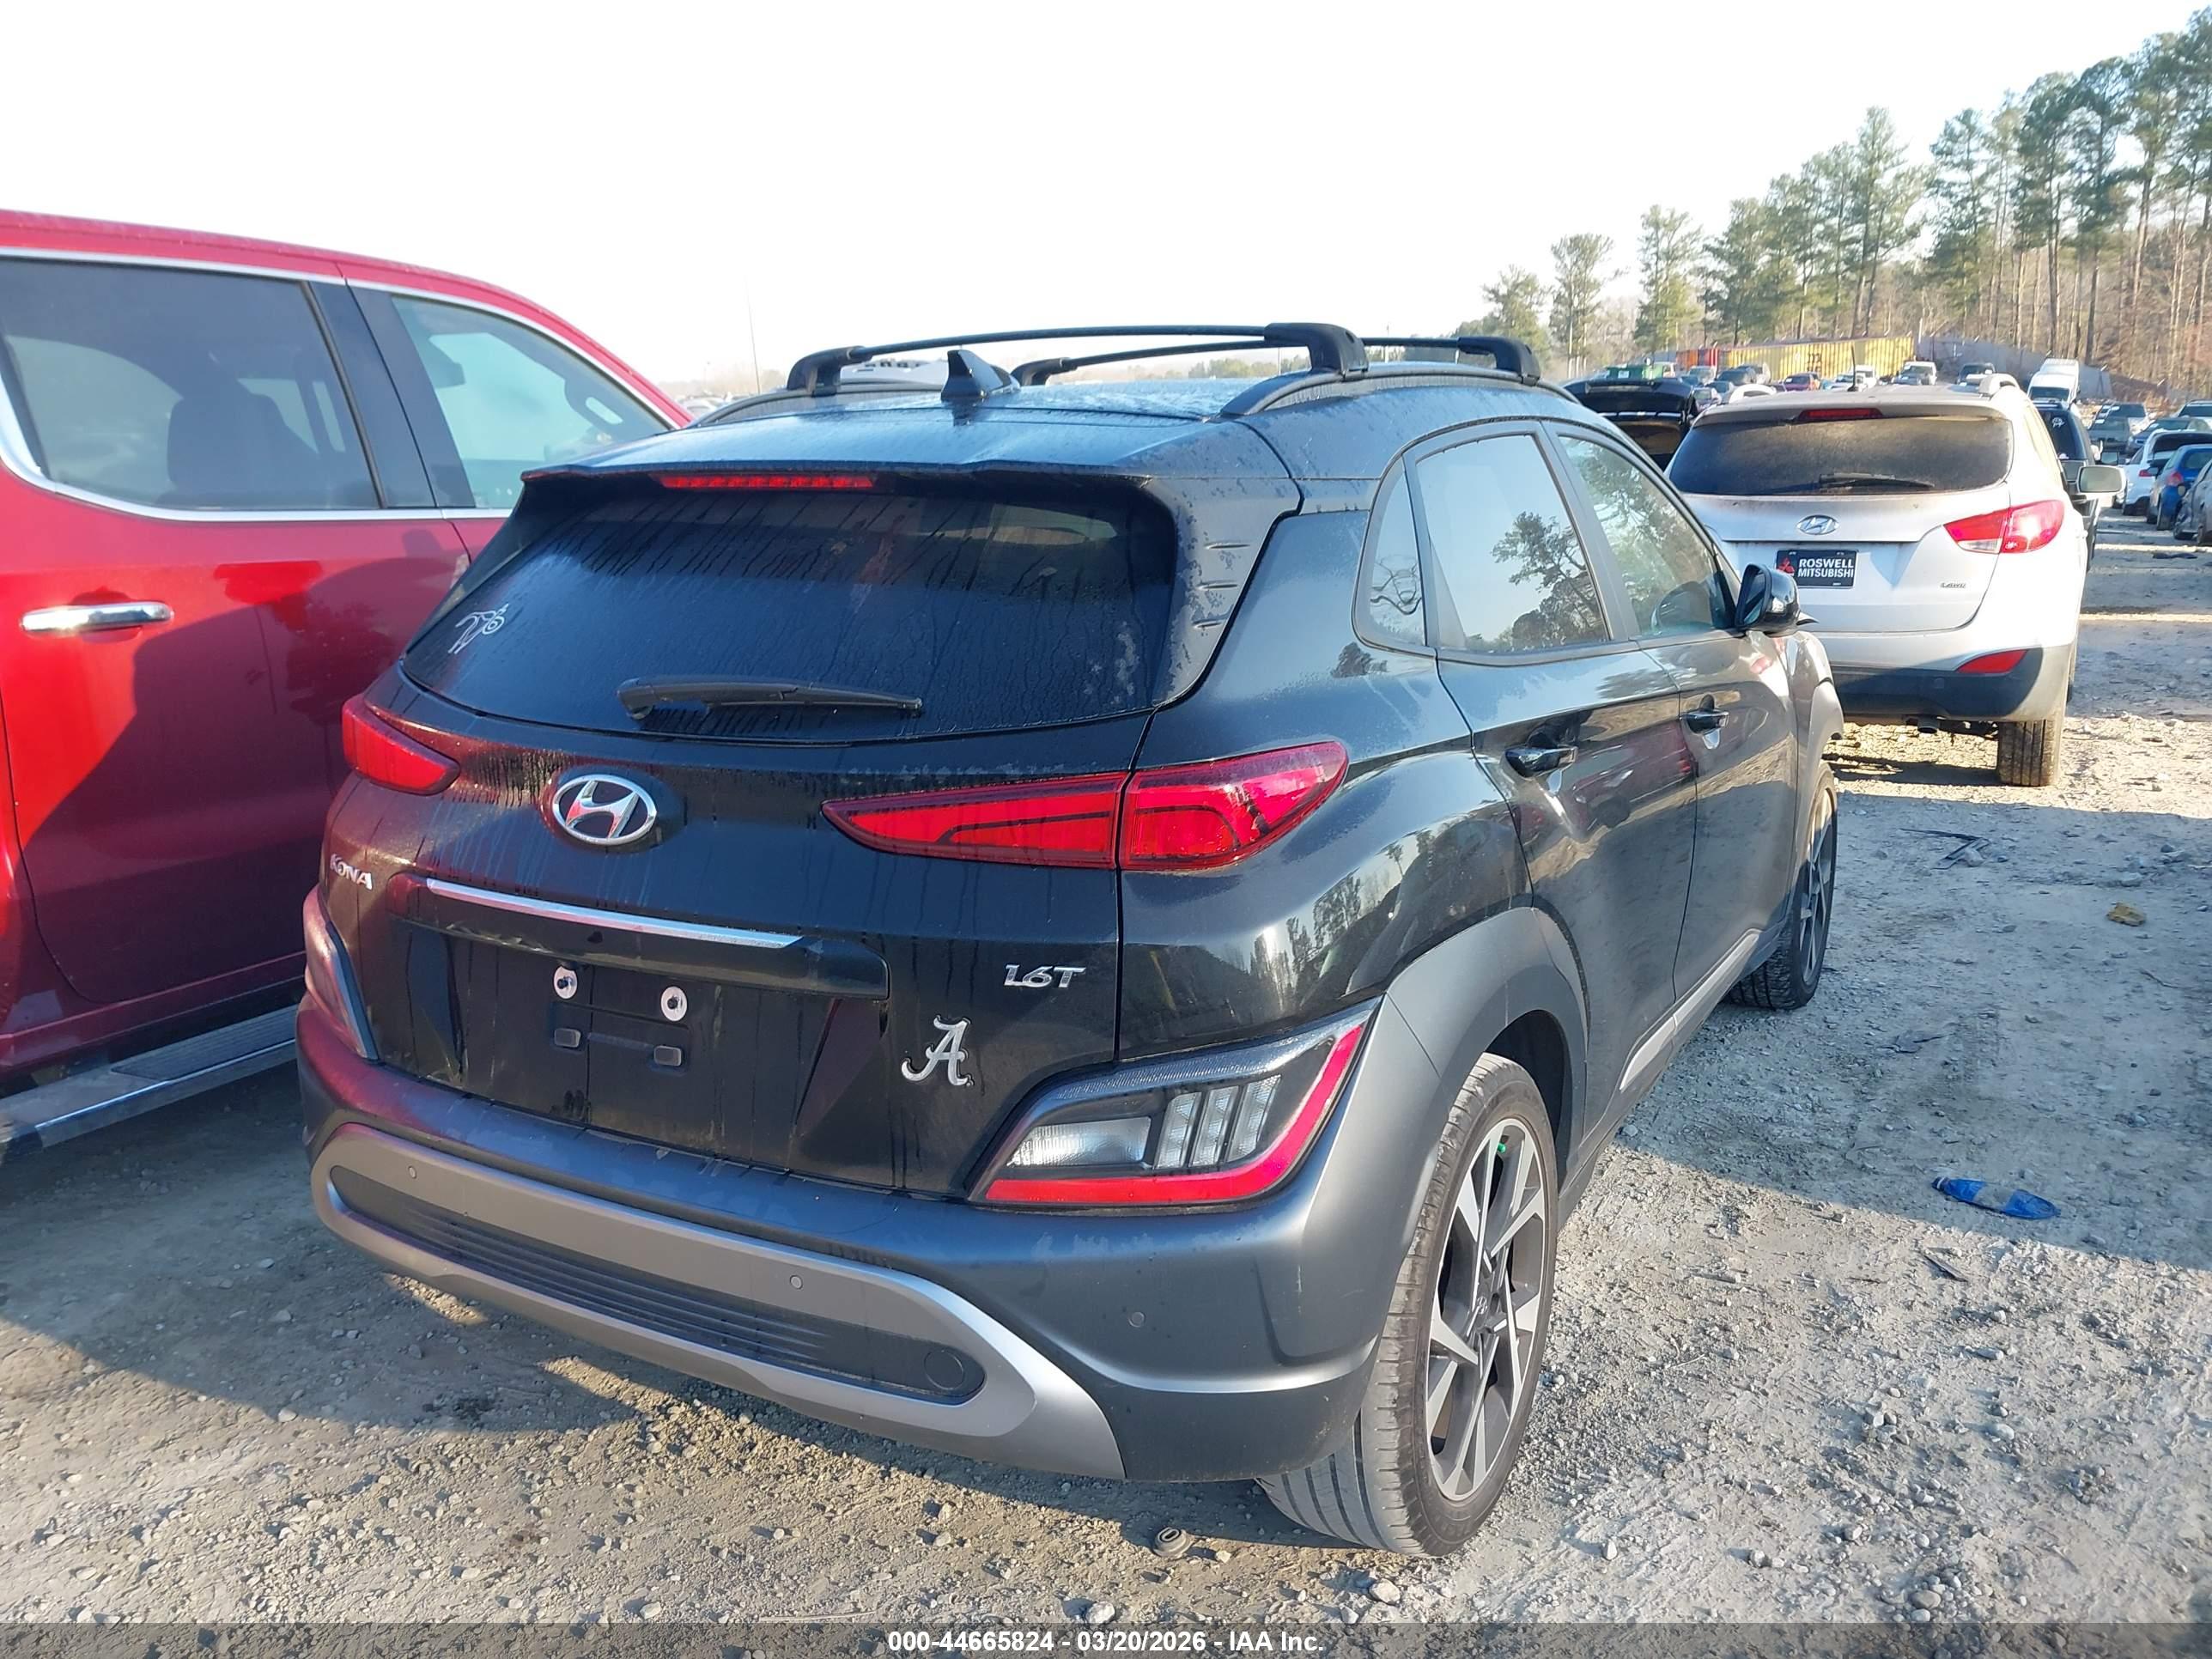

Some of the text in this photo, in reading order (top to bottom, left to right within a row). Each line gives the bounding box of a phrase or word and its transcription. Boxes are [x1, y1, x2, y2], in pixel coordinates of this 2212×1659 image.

[1799, 558, 1855, 568] ROSWELL
[1797, 568, 1855, 578] MITSUBISHI
[330, 854, 373, 890] KONA
